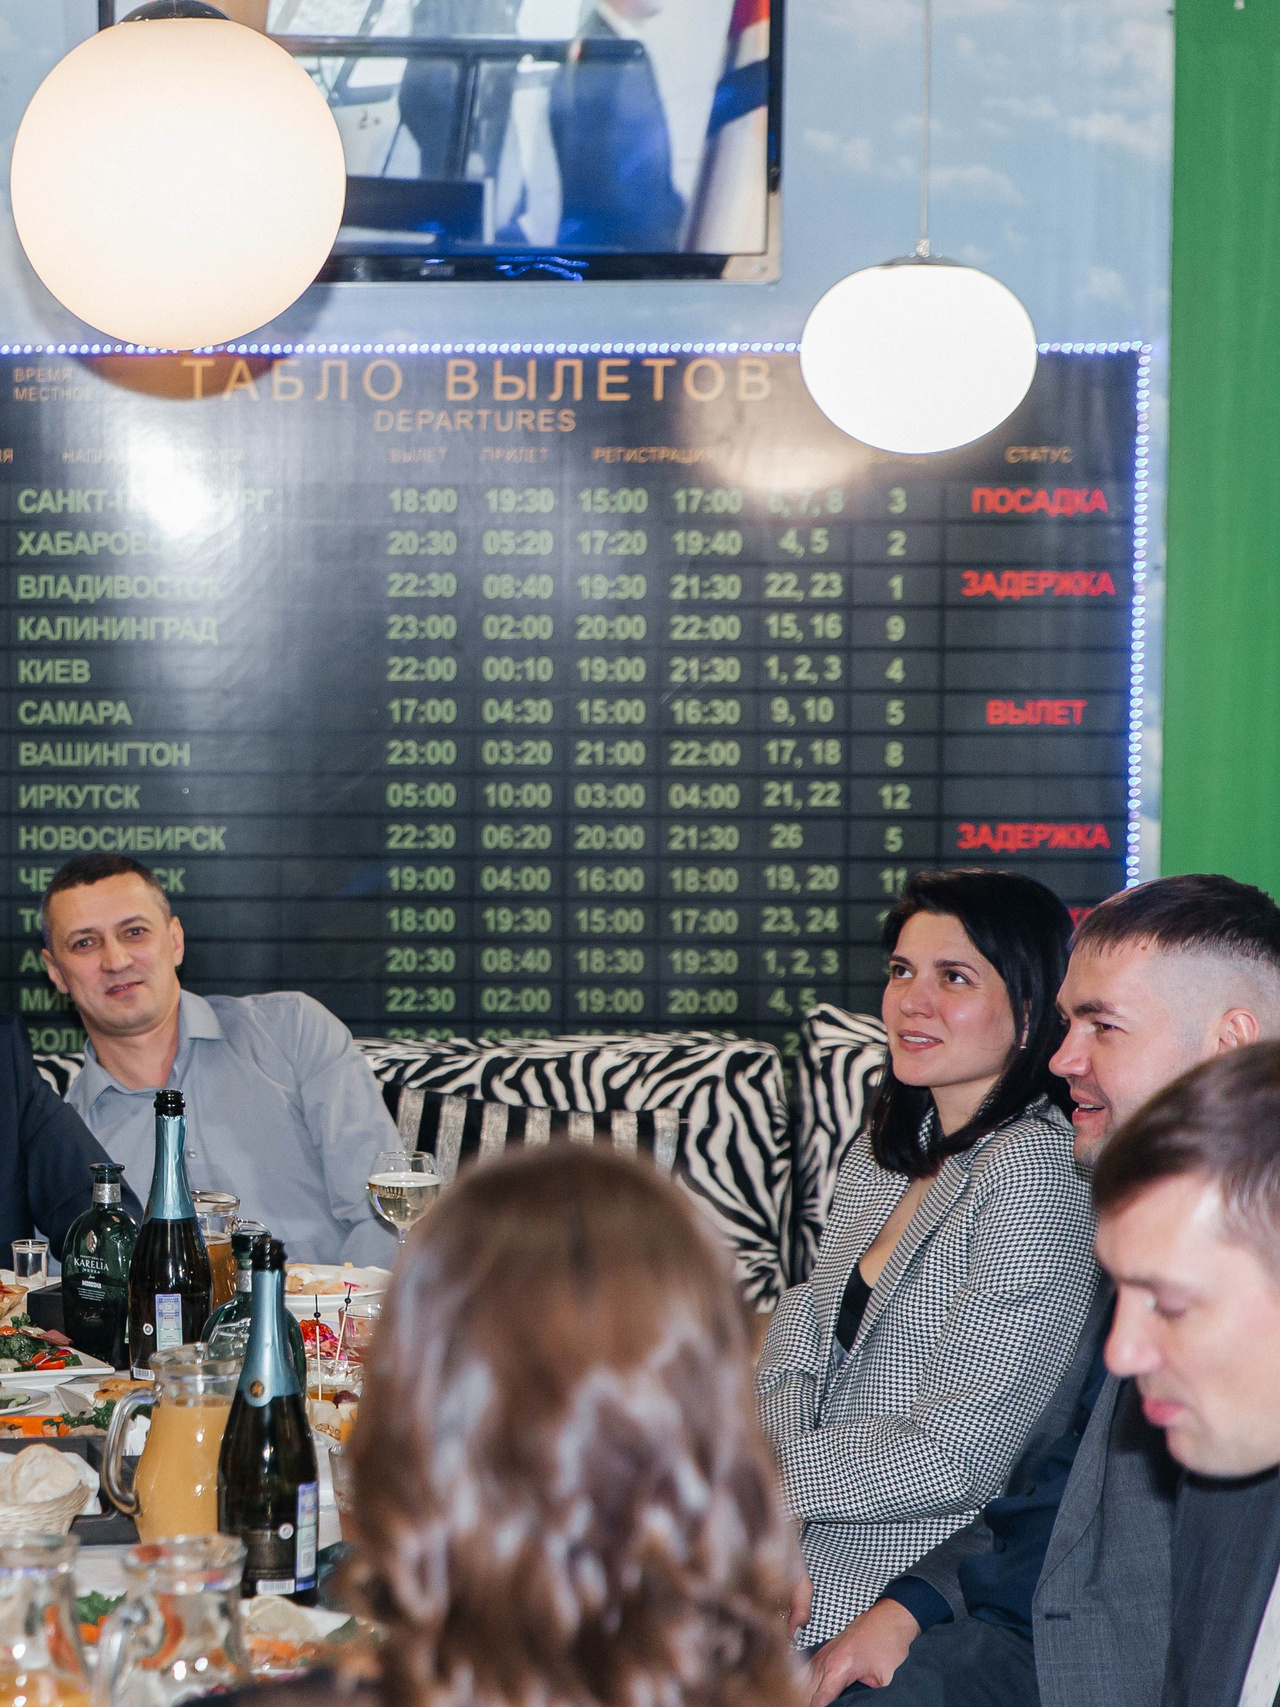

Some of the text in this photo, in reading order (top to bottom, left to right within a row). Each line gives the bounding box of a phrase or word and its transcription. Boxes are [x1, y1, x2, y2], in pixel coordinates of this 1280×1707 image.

[181, 357, 773, 402] ТАБЛО ВЫЛЕТОВ
[373, 408, 577, 433] DEPARTURES
[1005, 445, 1075, 464] СТАТУС
[389, 488, 458, 514] 18:00
[485, 488, 556, 514] 19:30
[580, 488, 649, 514] 15:00
[673, 488, 743, 514] 17:00
[888, 488, 907, 514] 3
[970, 486, 1110, 518] ПОСАДКА
[387, 529, 458, 556] 20:30
[482, 529, 554, 556] 05:20
[578, 529, 648, 556] 17:20
[673, 529, 743, 556] 19:40
[779, 528, 804, 559] 4,
[811, 528, 829, 556] 5
[887, 530, 907, 557] 2
[387, 571, 458, 598] 22:30
[482, 573, 554, 599] 08:40
[577, 574, 648, 600] 19:30
[670, 574, 742, 600] 21:30
[765, 573, 804, 603] 22,
[810, 573, 843, 600] 23
[888, 574, 904, 600] 1
[960, 570, 1117, 601] ЗАДЕРЖКА
[18, 616, 219, 645] КАЛИНИНГРАД
[386, 614, 458, 640] 23:00
[482, 614, 554, 640] 02:00
[576, 614, 647, 640] 20:00
[670, 614, 742, 641] 22:00
[765, 613, 804, 644] 15,
[810, 613, 843, 641] 16
[886, 615, 906, 642] 9
[18, 658, 91, 684] КИЕВ
[386, 656, 458, 682] 22:00
[482, 656, 554, 682] 00:10
[577, 656, 647, 682] 19:00
[670, 656, 741, 683] 21:30
[765, 655, 788, 686] 1,
[794, 655, 818, 686] 2,
[824, 655, 842, 683] 3
[885, 658, 905, 683] 4
[18, 700, 132, 725] САМАРА
[388, 698, 457, 724] 17:00
[482, 698, 554, 724] 04:30
[577, 698, 647, 724] 15:00
[671, 699, 741, 725] 16:30
[770, 698, 796, 728] 9,
[802, 698, 835, 725] 10
[886, 699, 905, 726] 5
[986, 700, 1088, 726] ВЫЛЕТ
[18, 741, 191, 767] ВАШИНГТОН
[386, 739, 457, 765] 23:00
[482, 739, 553, 766] 03:20
[575, 740, 646, 766] 21:00
[669, 740, 741, 766] 22:00
[765, 739, 803, 769] 17,
[810, 739, 842, 766] 18
[885, 741, 904, 768] 8
[19, 784, 140, 810] ИРКУТСК
[386, 782, 457, 808] 05:00
[484, 782, 553, 808] 10:00
[574, 782, 646, 809] 03:00
[668, 783, 741, 809] 04:00
[763, 782, 802, 812] 21,
[808, 782, 841, 809] 22
[879, 783, 911, 810] 12
[18, 825, 227, 851] НОВОСИБИРСК
[386, 824, 456, 850] 22:30
[481, 824, 552, 850] 06:20
[574, 824, 645, 850] 20:00
[668, 825, 740, 851] 21:30
[770, 824, 804, 851] 26
[885, 826, 904, 853] 5
[957, 822, 1110, 853] ЗАДЕРЖКА
[387, 866, 456, 891] 19:00
[480, 866, 552, 892] 04:00
[576, 866, 645, 892] 16:00
[670, 867, 739, 893] 18:00
[763, 866, 801, 896] 19,
[806, 866, 840, 893] 20
[387, 907, 456, 933] 18:00
[482, 907, 552, 933] 19:30
[575, 907, 645, 934] 15:00
[670, 908, 739, 934] 17:00
[762, 907, 801, 937] 23,
[806, 907, 840, 934] 24
[386, 947, 456, 973] 20:30
[481, 947, 552, 973] 08:40
[575, 948, 645, 974] 18:30
[669, 949, 739, 975] 19:30
[763, 948, 786, 978] 1,
[791, 948, 816, 978] 2,
[821, 948, 840, 975] 3
[386, 987, 456, 1012] 22:30
[481, 987, 552, 1013] 02:00
[575, 987, 645, 1014] 19:00
[668, 988, 739, 1014] 20:00
[770, 987, 793, 1017] 4,
[73, 1257, 110, 1272] KARELIA
